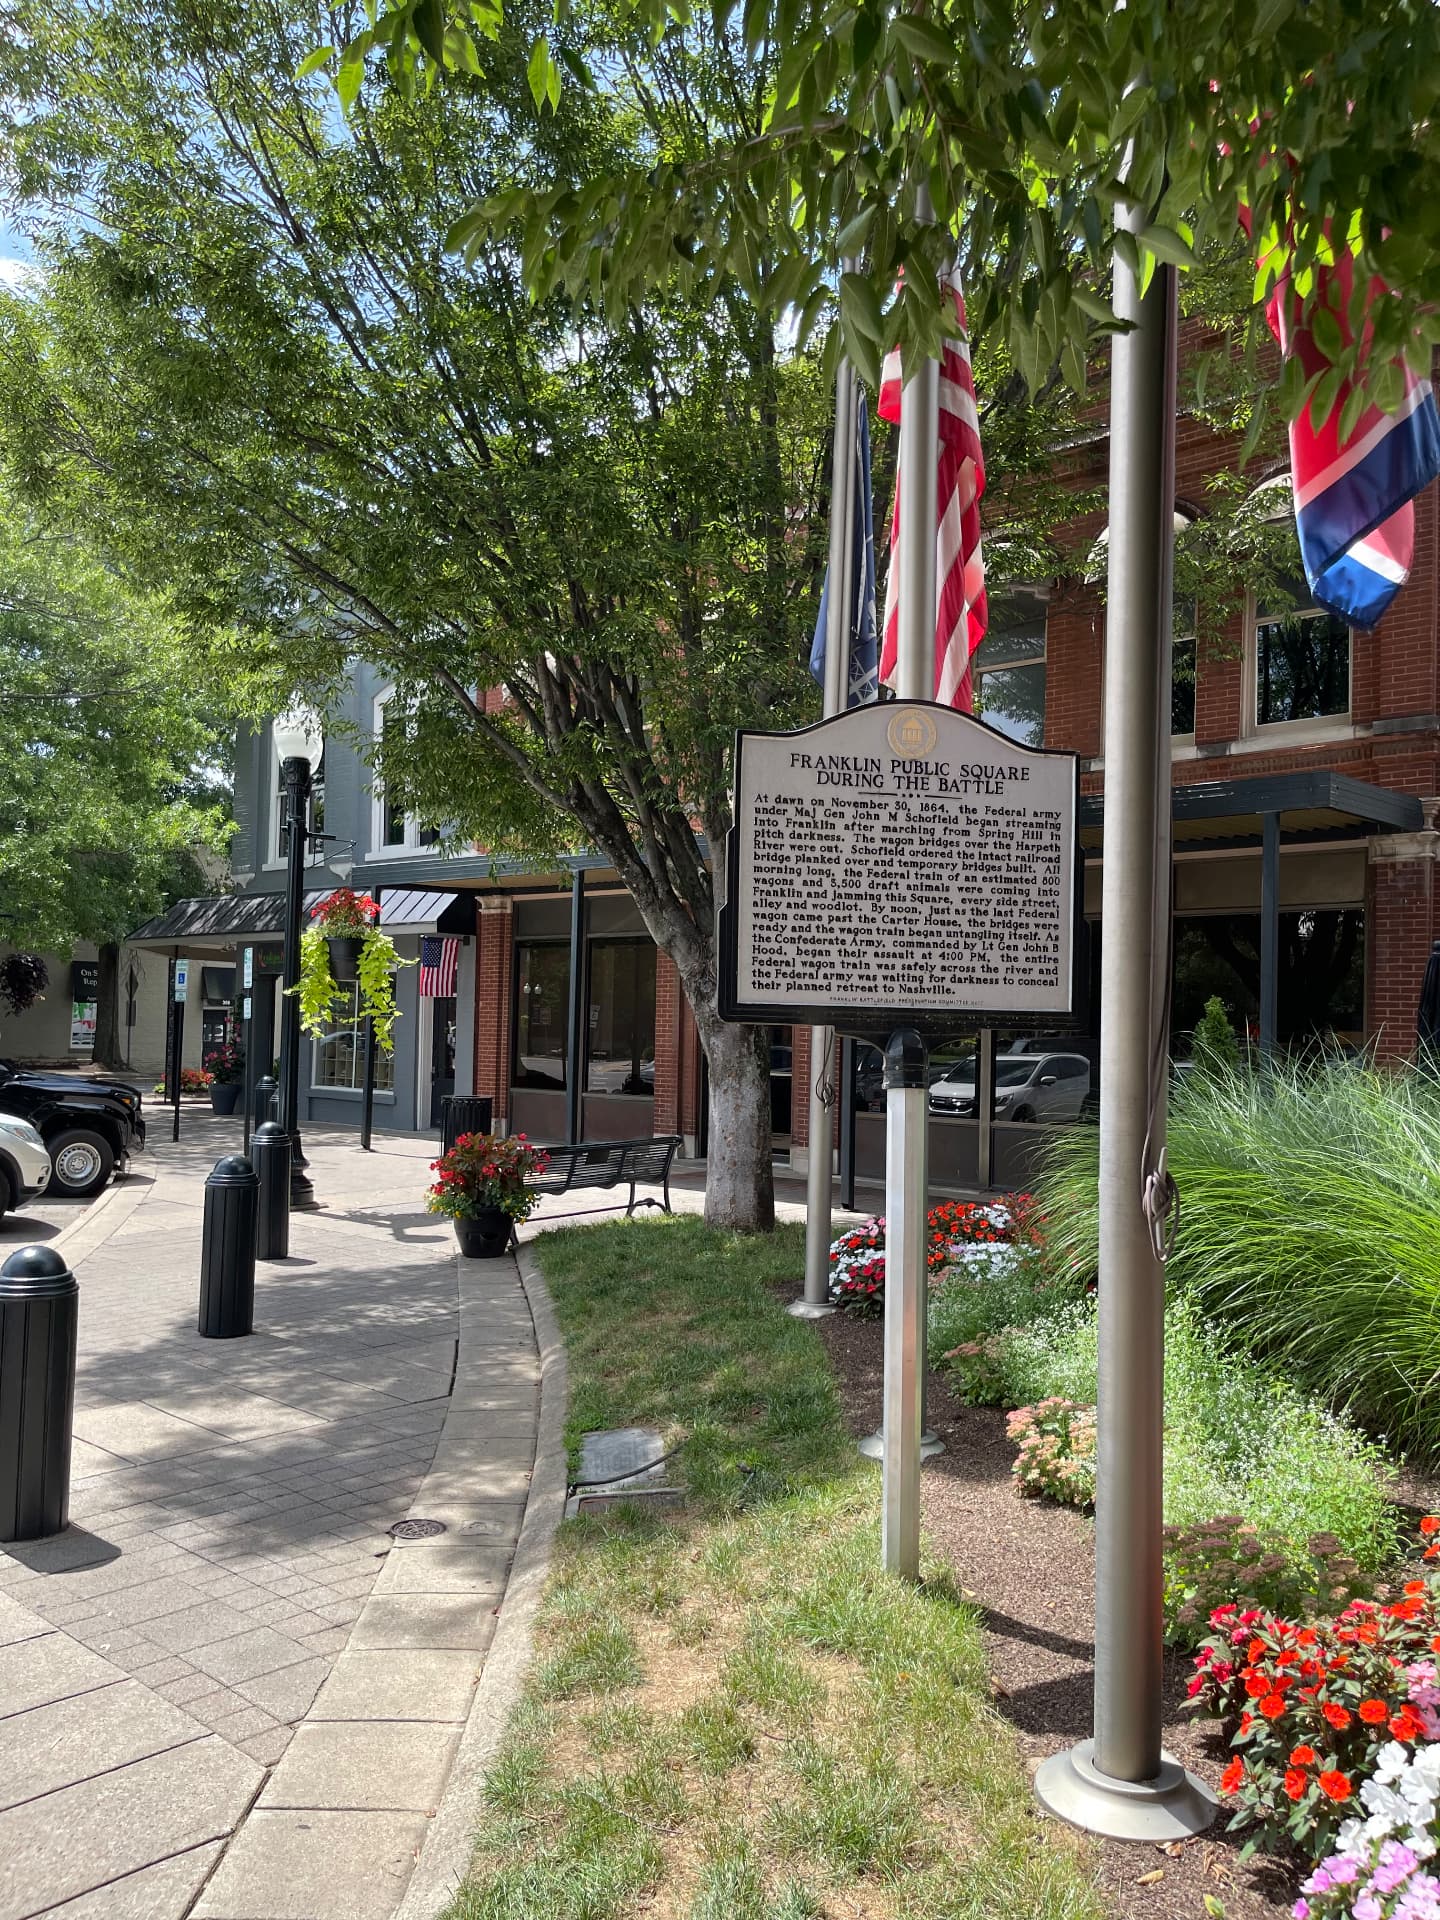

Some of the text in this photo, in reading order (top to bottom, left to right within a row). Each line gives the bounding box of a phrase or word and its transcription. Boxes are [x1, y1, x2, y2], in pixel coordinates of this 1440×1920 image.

[790, 753, 1030, 781] FRANKLIN PUBLIC SQUARE
[816, 771, 1004, 795] DURING THE BATTLE
[754, 795, 768, 804] At
[774, 796, 803, 806] dawn
[831, 799, 888, 809] November
[894, 801, 910, 812] 30,
[958, 804, 977, 813] the
[984, 805, 1025, 815] Federal
[1032, 809, 1061, 819] army
[754, 807, 787, 817] under
[823, 810, 844, 819] Gen
[851, 811, 879, 820] John
[888, 813, 897, 821] M
[904, 813, 958, 824] Schofield
[965, 816, 998, 828] began
[1005, 818, 1061, 830] streaming
[785, 820, 835, 830] Franklin
[843, 822, 874, 832] after
[881, 824, 935, 836] marching
[942, 826, 970, 836] from
[978, 828, 1014, 840] Spring
[1022, 829, 1042, 838] Hill
[1050, 831, 1060, 839] in
[754, 830, 1060, 853] pitch darkness. The wagon bridges over the Harpeth
[753, 842, 1060, 862] River were out. Schofield ordered the intact railroad
[753, 853, 1060, 873] bridge planked over and temporary bridges built. All
[753, 865, 801, 878] morning
[843, 868, 862, 877] the
[866, 869, 909, 879] Federal
[913, 871, 942, 880] train
[947, 872, 959, 881] of
[981, 873, 1036, 884] estimated
[753, 878, 793, 888] wagons
[802, 878, 822, 887] and
[867, 880, 899, 890] draft
[906, 882, 949, 891] animals
[956, 885, 982, 893] were
[990, 885, 1030, 897] coming
[753, 888, 802, 898] Franklin
[806, 890, 827, 899] and
[831, 890, 881, 903] jamming
[884, 892, 906, 901] this
[910, 893, 953, 905] Square,
[960, 897, 992, 907] every
[996, 896, 1018, 905] side
[752, 899, 782, 911] alley
[786, 900, 807, 909] and
[811, 901, 862, 911] woodlot.
[871, 903, 885, 914] By
[930, 905, 950, 916] just
[969, 906, 988, 915] the
[993, 907, 1013, 916] last
[1018, 908, 1058, 918] Federal
[752, 913, 787, 923] wagon
[792, 914, 822, 922] came
[827, 914, 852, 925] past
[857, 914, 876, 923] the
[881, 915, 919, 925] Carter
[967, 918, 985, 927] the
[989, 919, 1029, 930] bridges
[752, 922, 1058, 941] ready and the wagon train began untangling itself. As
[753, 934, 771, 943] the
[774, 935, 846, 945] Confederate
[892, 938, 959, 949] commanded
[963, 940, 976, 952] by
[982, 941, 993, 950] Lt
[997, 942, 1018, 950] Gen
[1022, 942, 1048, 951] John
[1052, 943, 1058, 952] B
[795, 947, 830, 959] began
[837, 948, 867, 957] their
[873, 949, 914, 959] assault
[921, 951, 932, 959] at
[938, 951, 963, 960] 4:00
[999, 953, 1018, 962] the
[1024, 954, 1058, 963] entire
[751, 957, 795, 967] Federal
[800, 961, 835, 970] wagon
[839, 960, 870, 969] train
[901, 962, 936, 973] safely
[980, 964, 998, 972] the
[1005, 964, 1033, 973] river
[1038, 965, 1058, 974] and
[751, 969, 771, 978] the
[774, 970, 818, 979] Federal
[822, 973, 853, 982] army
[881, 972, 923, 984] waiting
[928, 974, 945, 982] for
[949, 974, 998, 984] darkness
[1002, 976, 1014, 984] to
[1017, 976, 1058, 985] conceal
[751, 980, 955, 994] their planned retreat to Nashville.
